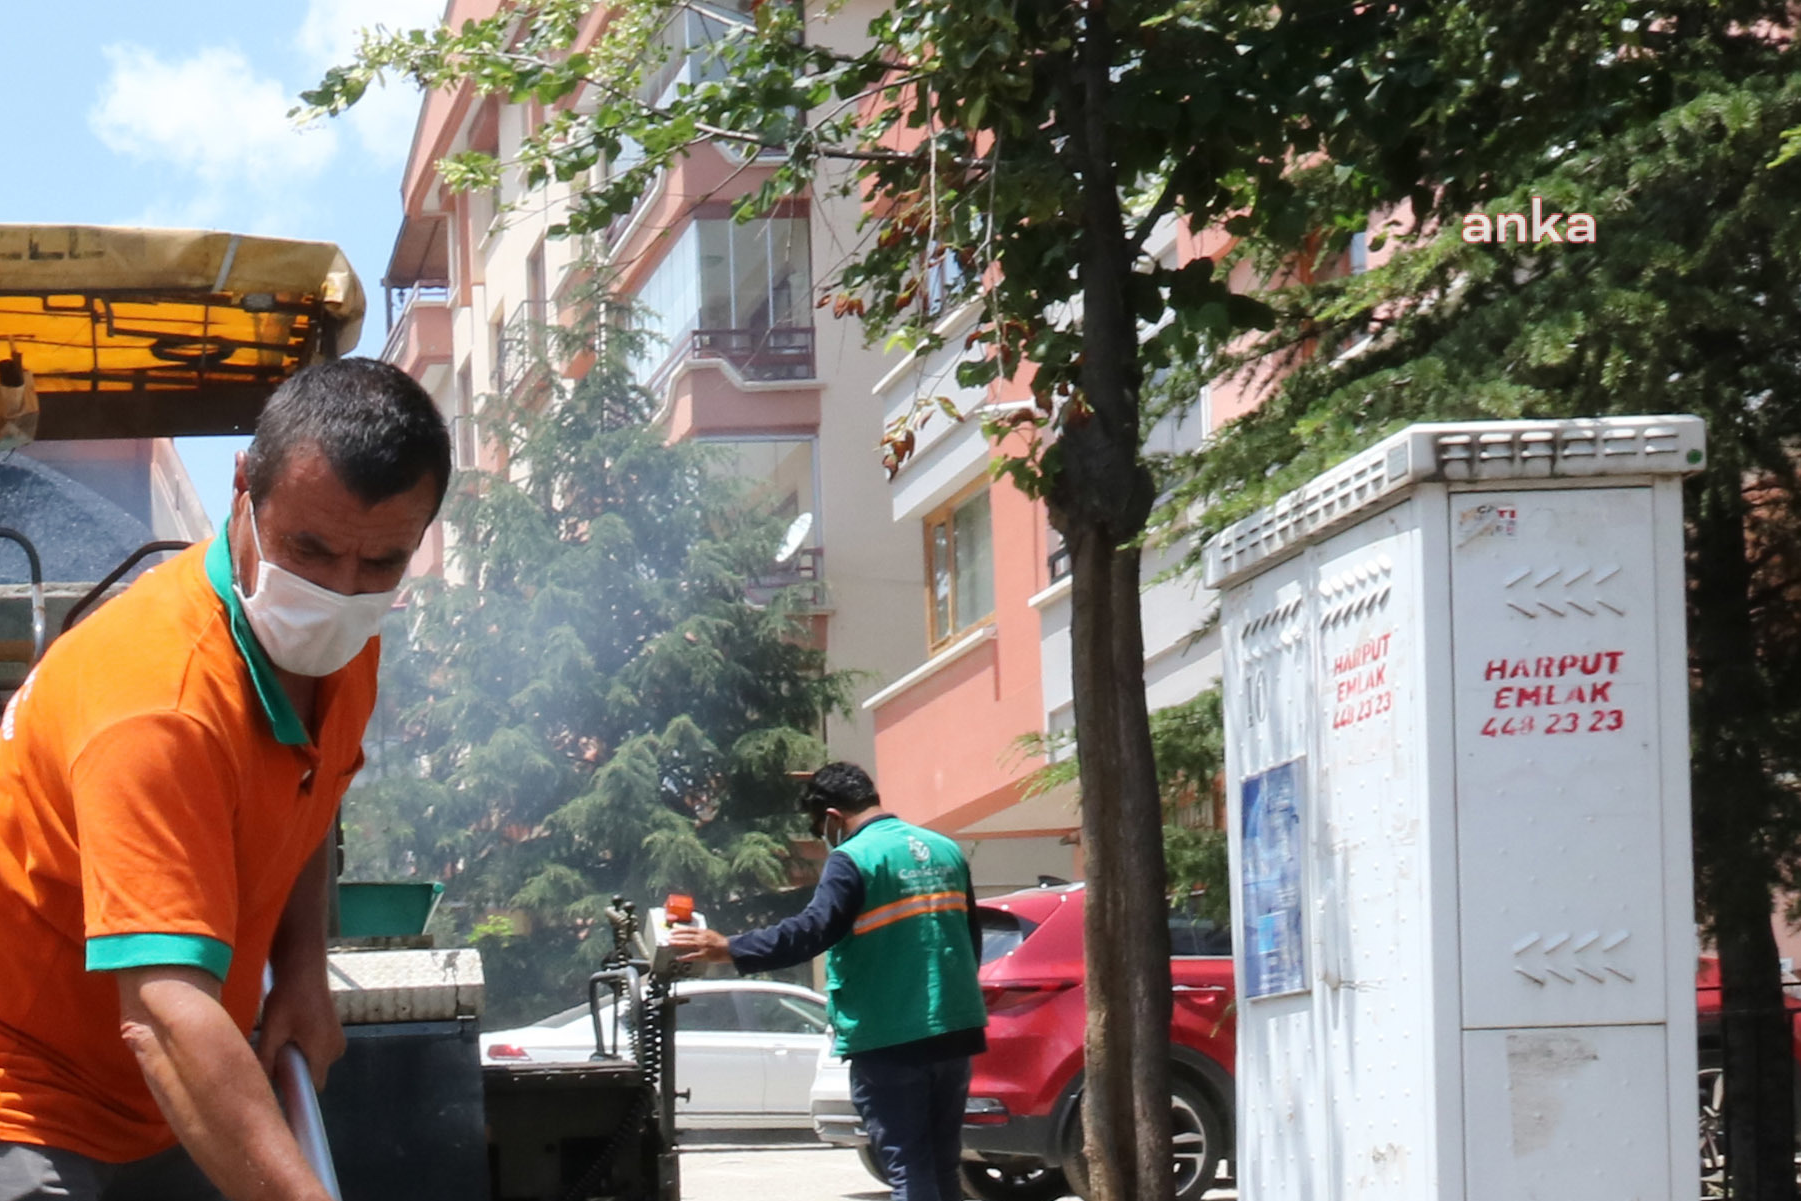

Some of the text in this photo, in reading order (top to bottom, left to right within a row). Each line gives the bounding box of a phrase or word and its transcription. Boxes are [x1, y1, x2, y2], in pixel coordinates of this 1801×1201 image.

[1334, 632, 1392, 677] HARPUT
[1485, 651, 1625, 681] HARPUT
[1337, 662, 1387, 703] EMLAK
[1494, 681, 1613, 709] EMLAK
[1375, 691, 1392, 714] 23
[1544, 712, 1580, 734] 23
[1588, 709, 1624, 732] 23
